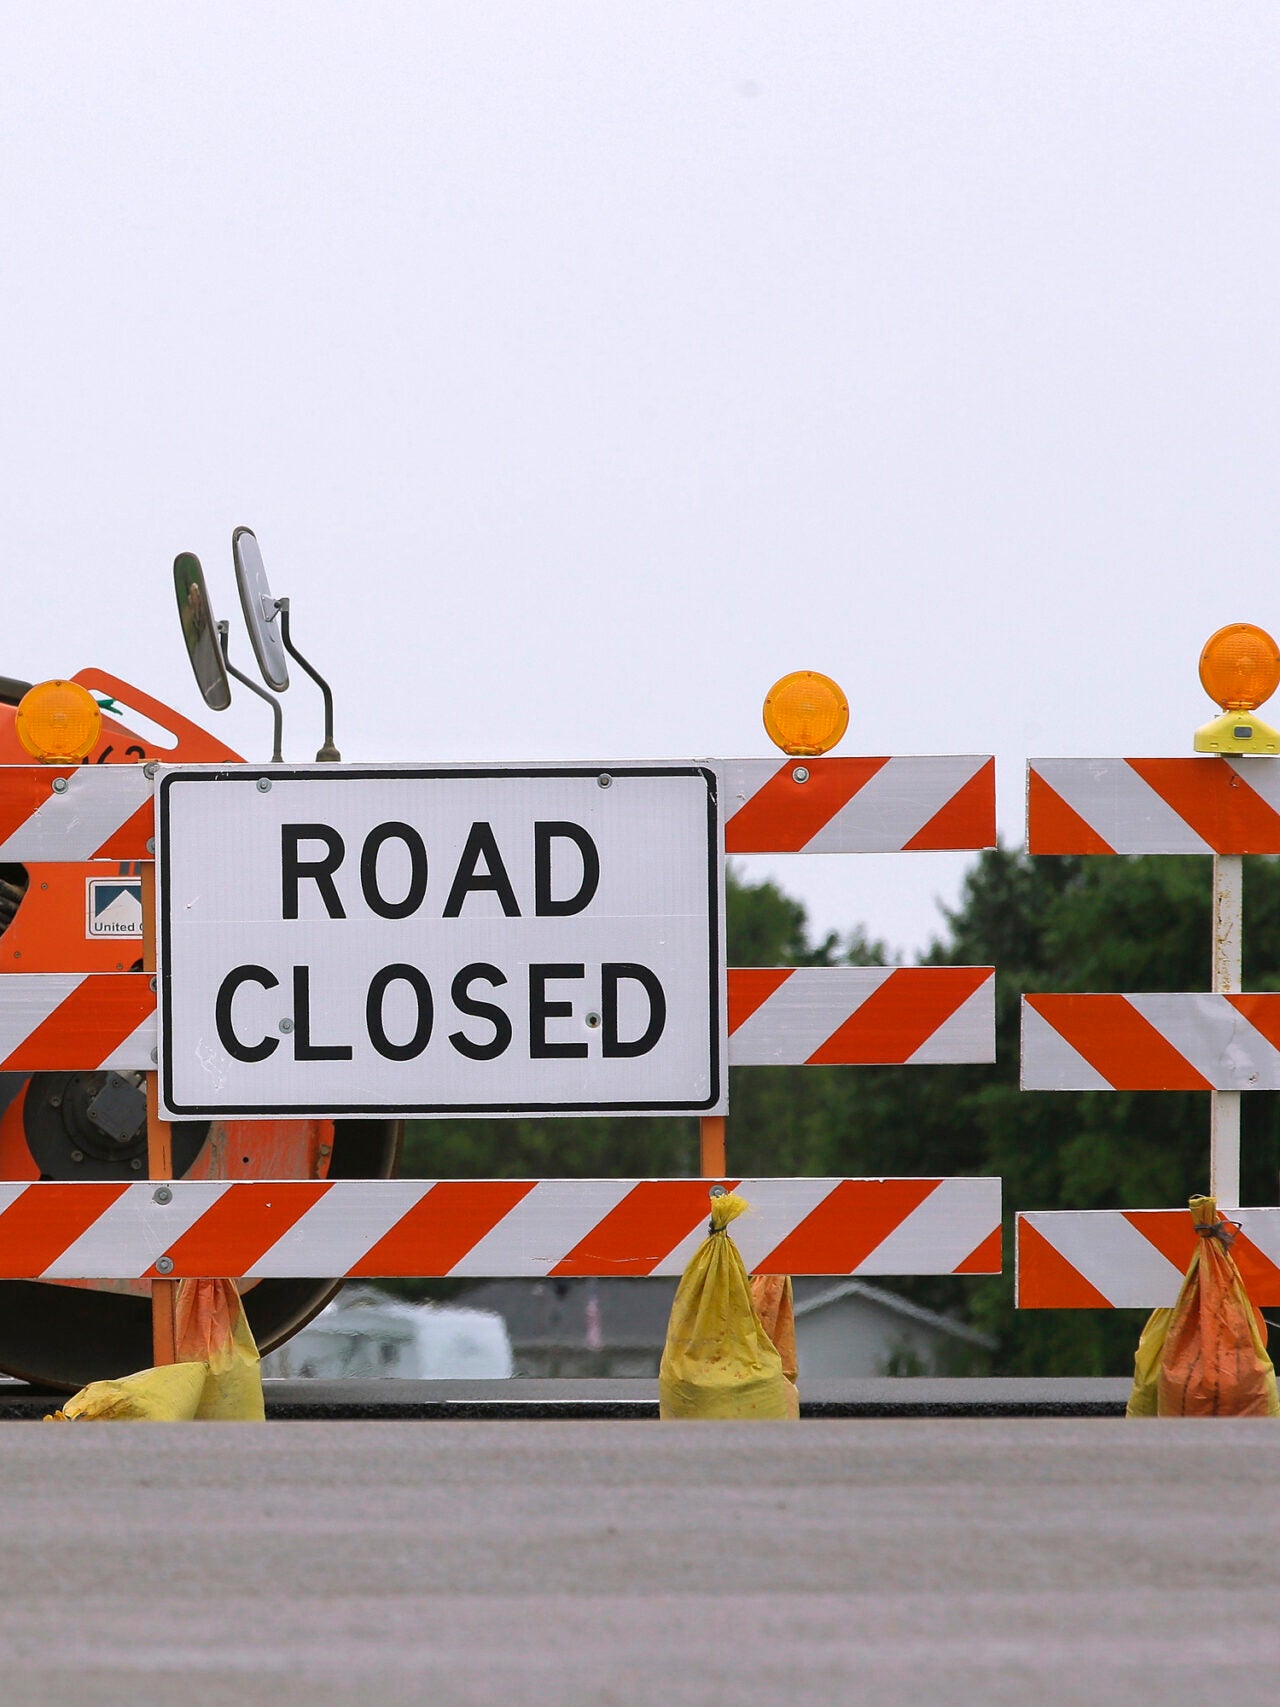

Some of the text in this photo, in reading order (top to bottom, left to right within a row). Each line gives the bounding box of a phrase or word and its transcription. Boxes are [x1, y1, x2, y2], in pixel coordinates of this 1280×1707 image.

[281, 821, 600, 920] ROAD
[94, 922, 135, 932] United
[215, 961, 667, 1063] CLOSED
